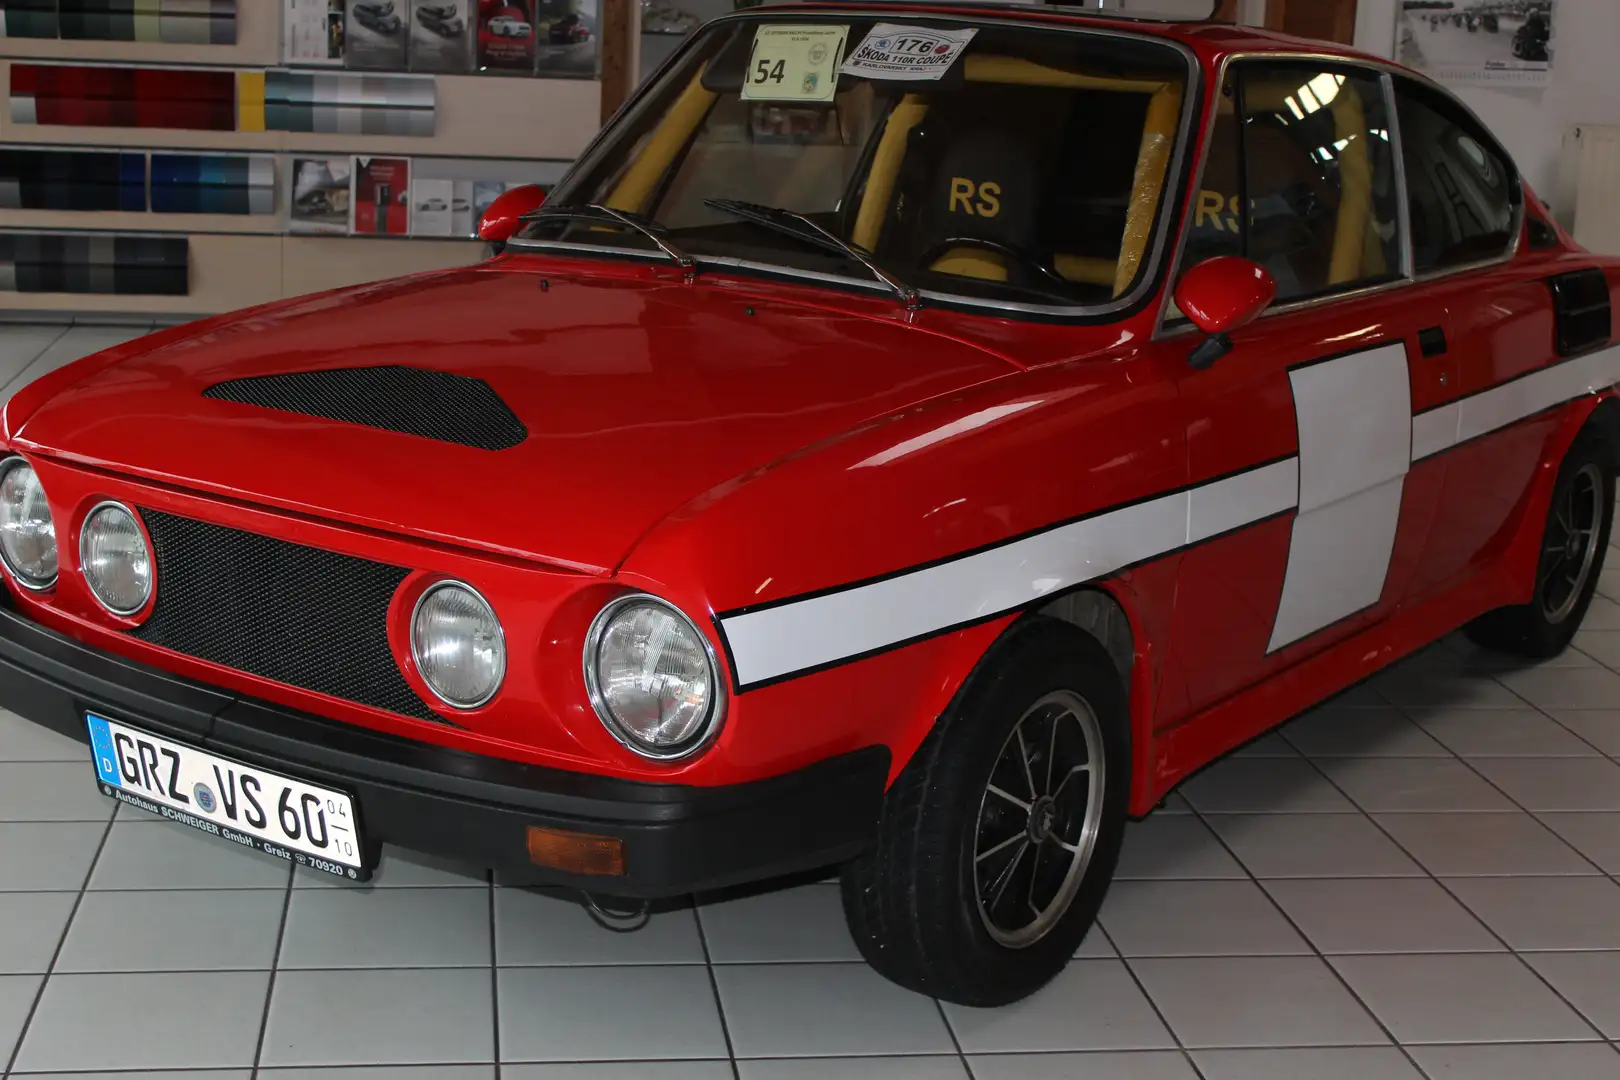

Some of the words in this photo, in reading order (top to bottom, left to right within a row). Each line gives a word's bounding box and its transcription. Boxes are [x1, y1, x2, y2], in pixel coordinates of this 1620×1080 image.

[857, 44, 891, 62] ŠKODA
[891, 55, 916, 64] 110R
[916, 49, 955, 64] COUPÉ
[896, 38, 934, 53] 176
[754, 59, 786, 84] 54
[948, 176, 1002, 218] RS
[102, 757, 113, 773] D
[114, 732, 190, 805] GRZ
[212, 764, 267, 829] VS
[278, 786, 329, 849] 60
[326, 799, 346, 818] 04
[115, 789, 159, 813] Autohaus
[160, 806, 220, 835] SCHWEIGER
[222, 828, 254, 848] GmbH
[263, 842, 292, 860] Greiz
[308, 856, 343, 876] 70920
[335, 838, 353, 857] 10
